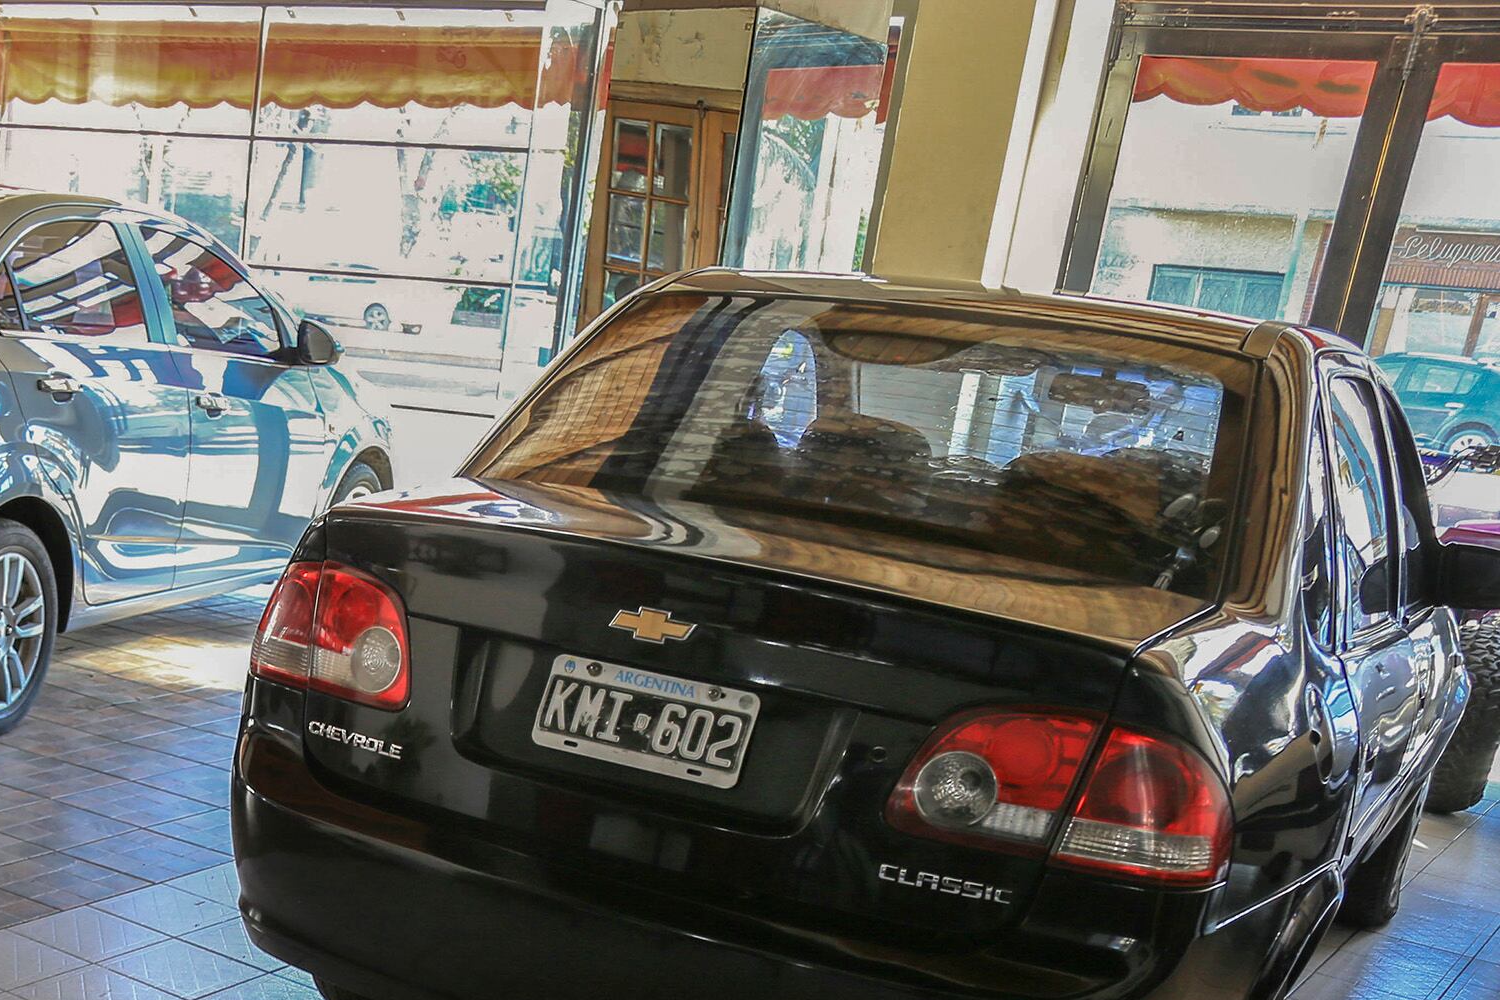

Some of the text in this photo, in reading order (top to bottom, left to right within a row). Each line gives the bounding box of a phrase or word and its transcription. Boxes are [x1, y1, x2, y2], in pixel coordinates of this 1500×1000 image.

[614, 669, 697, 699] ARGENTINA
[308, 720, 404, 760] CHEVROLE
[543, 679, 743, 768] KMI 602
[878, 863, 1013, 905] CLASSIC
